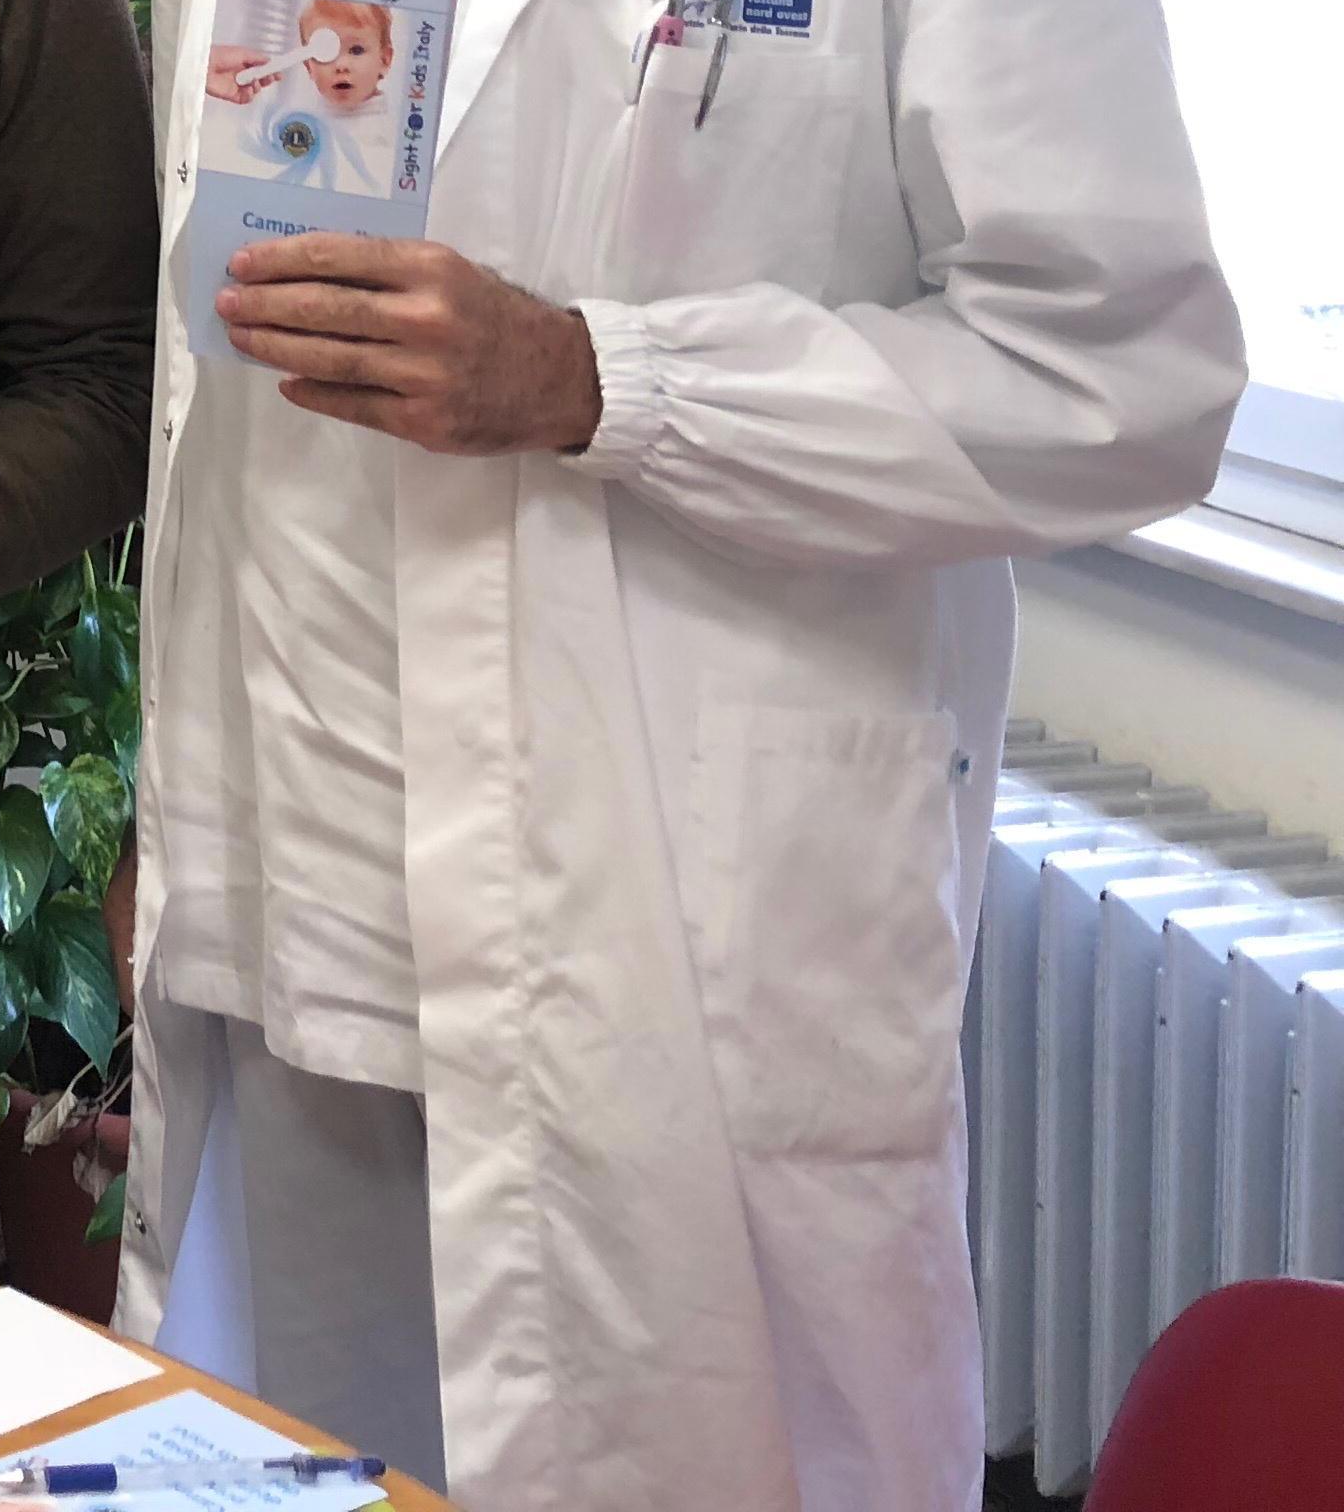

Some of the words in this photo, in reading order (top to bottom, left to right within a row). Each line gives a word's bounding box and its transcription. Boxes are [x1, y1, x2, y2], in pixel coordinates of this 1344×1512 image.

[746, 7, 772, 18] nord
[776, 11, 808, 21] ovest
[413, 21, 435, 60] Italy
[408, 64, 428, 100] Kids
[399, 144, 420, 191] Sight
[243, 211, 329, 237] Campa
